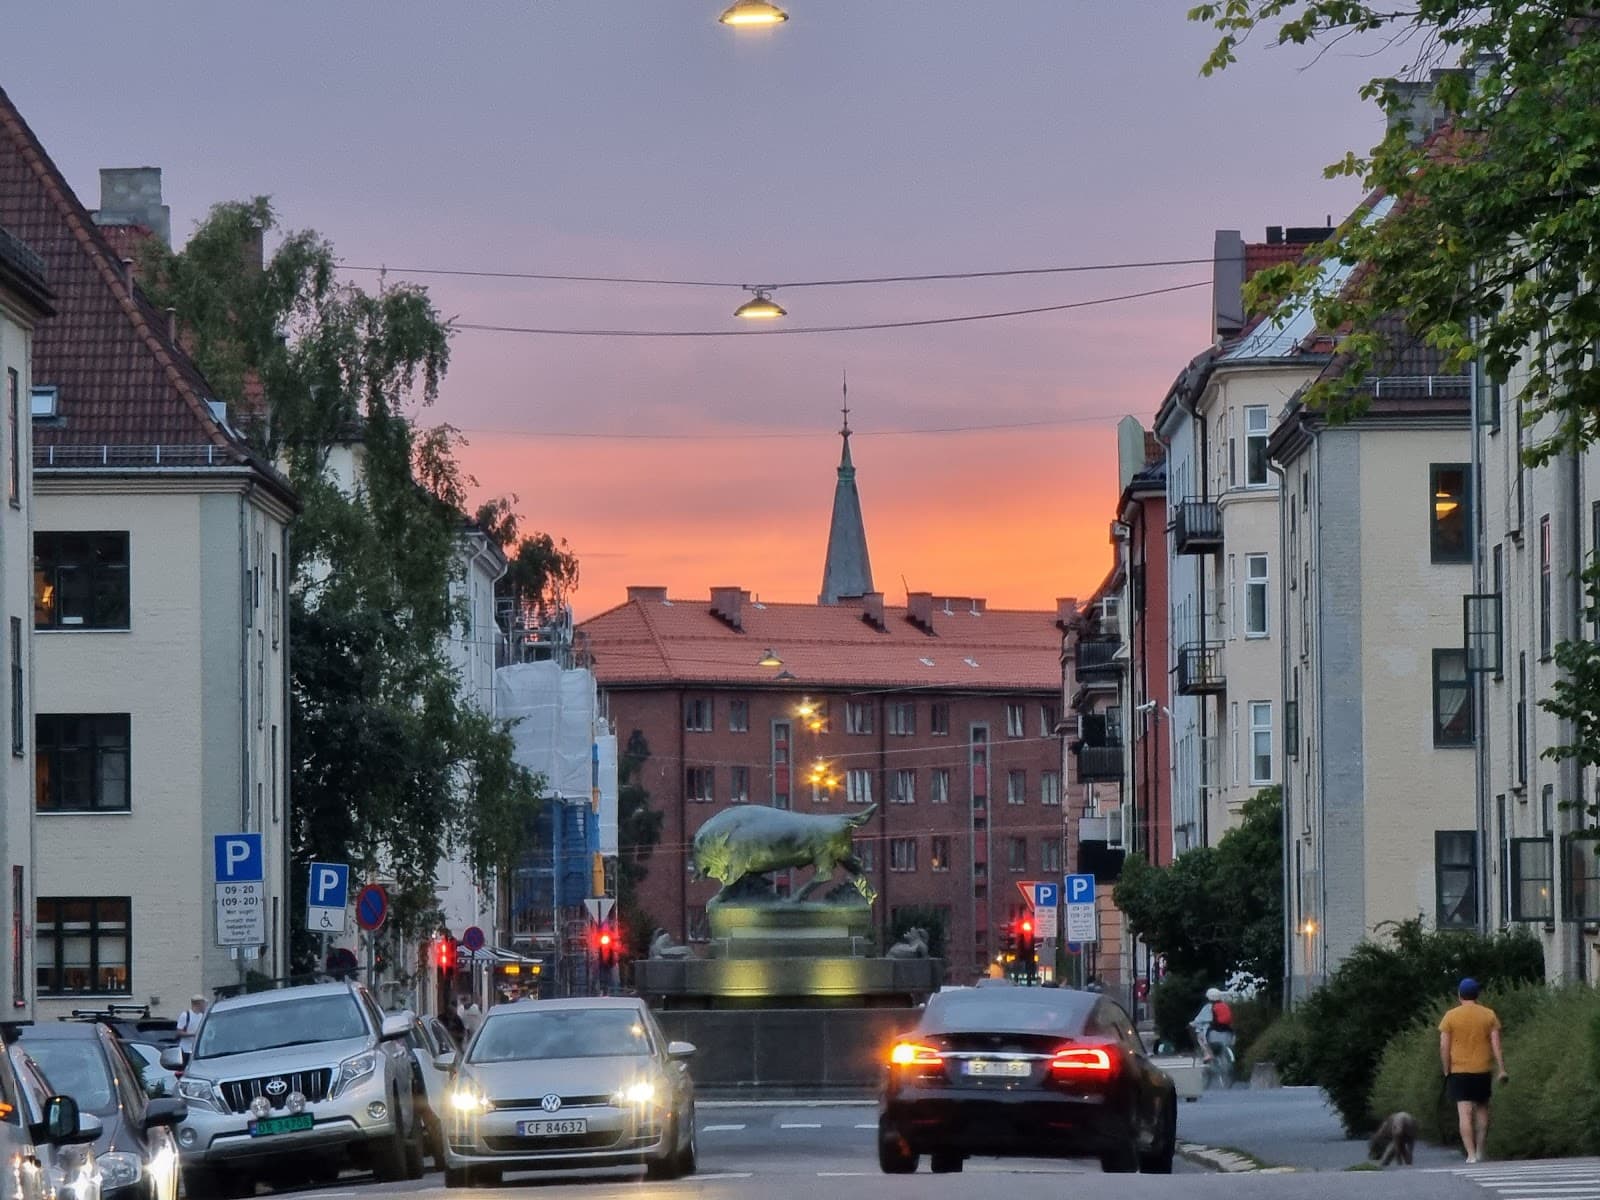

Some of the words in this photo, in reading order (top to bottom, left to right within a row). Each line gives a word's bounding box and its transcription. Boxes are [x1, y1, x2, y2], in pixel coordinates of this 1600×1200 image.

[226, 840, 251, 876] P
[318, 869, 339, 902] P
[1039, 886, 1052, 905] P
[1072, 878, 1088, 900] P
[527, 1123, 541, 1134] CF
[546, 1121, 583, 1134] 84632
